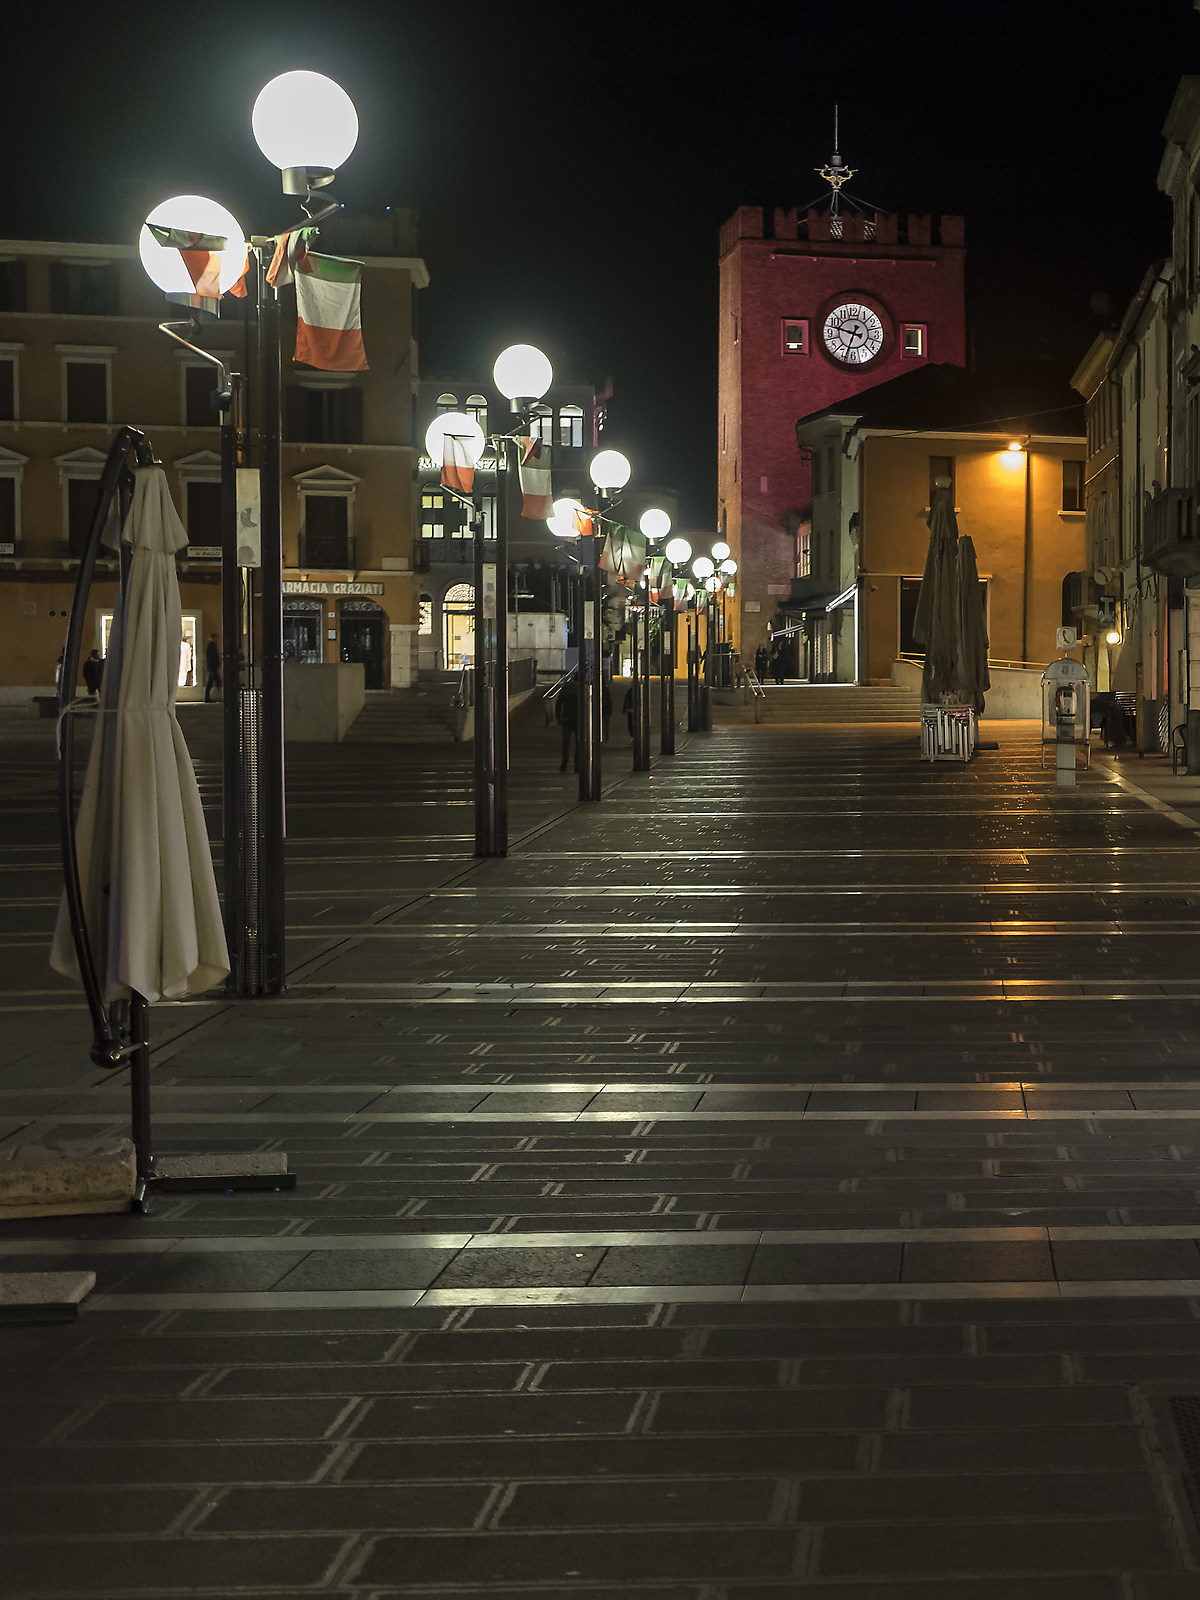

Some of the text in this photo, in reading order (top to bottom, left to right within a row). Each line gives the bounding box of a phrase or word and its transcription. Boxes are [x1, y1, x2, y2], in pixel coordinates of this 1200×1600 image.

[840, 310, 846, 319] 11
[849, 307, 858, 317] 12
[829, 317, 840, 327] 10
[870, 318, 876, 328] 2
[827, 328, 833, 338] 9
[873, 330, 880, 340] 3
[831, 340, 837, 350] 8
[850, 351, 857, 361] 6
[861, 348, 868, 358] 5
[282, 581, 383, 595] ARMACIA GRAZIATI
